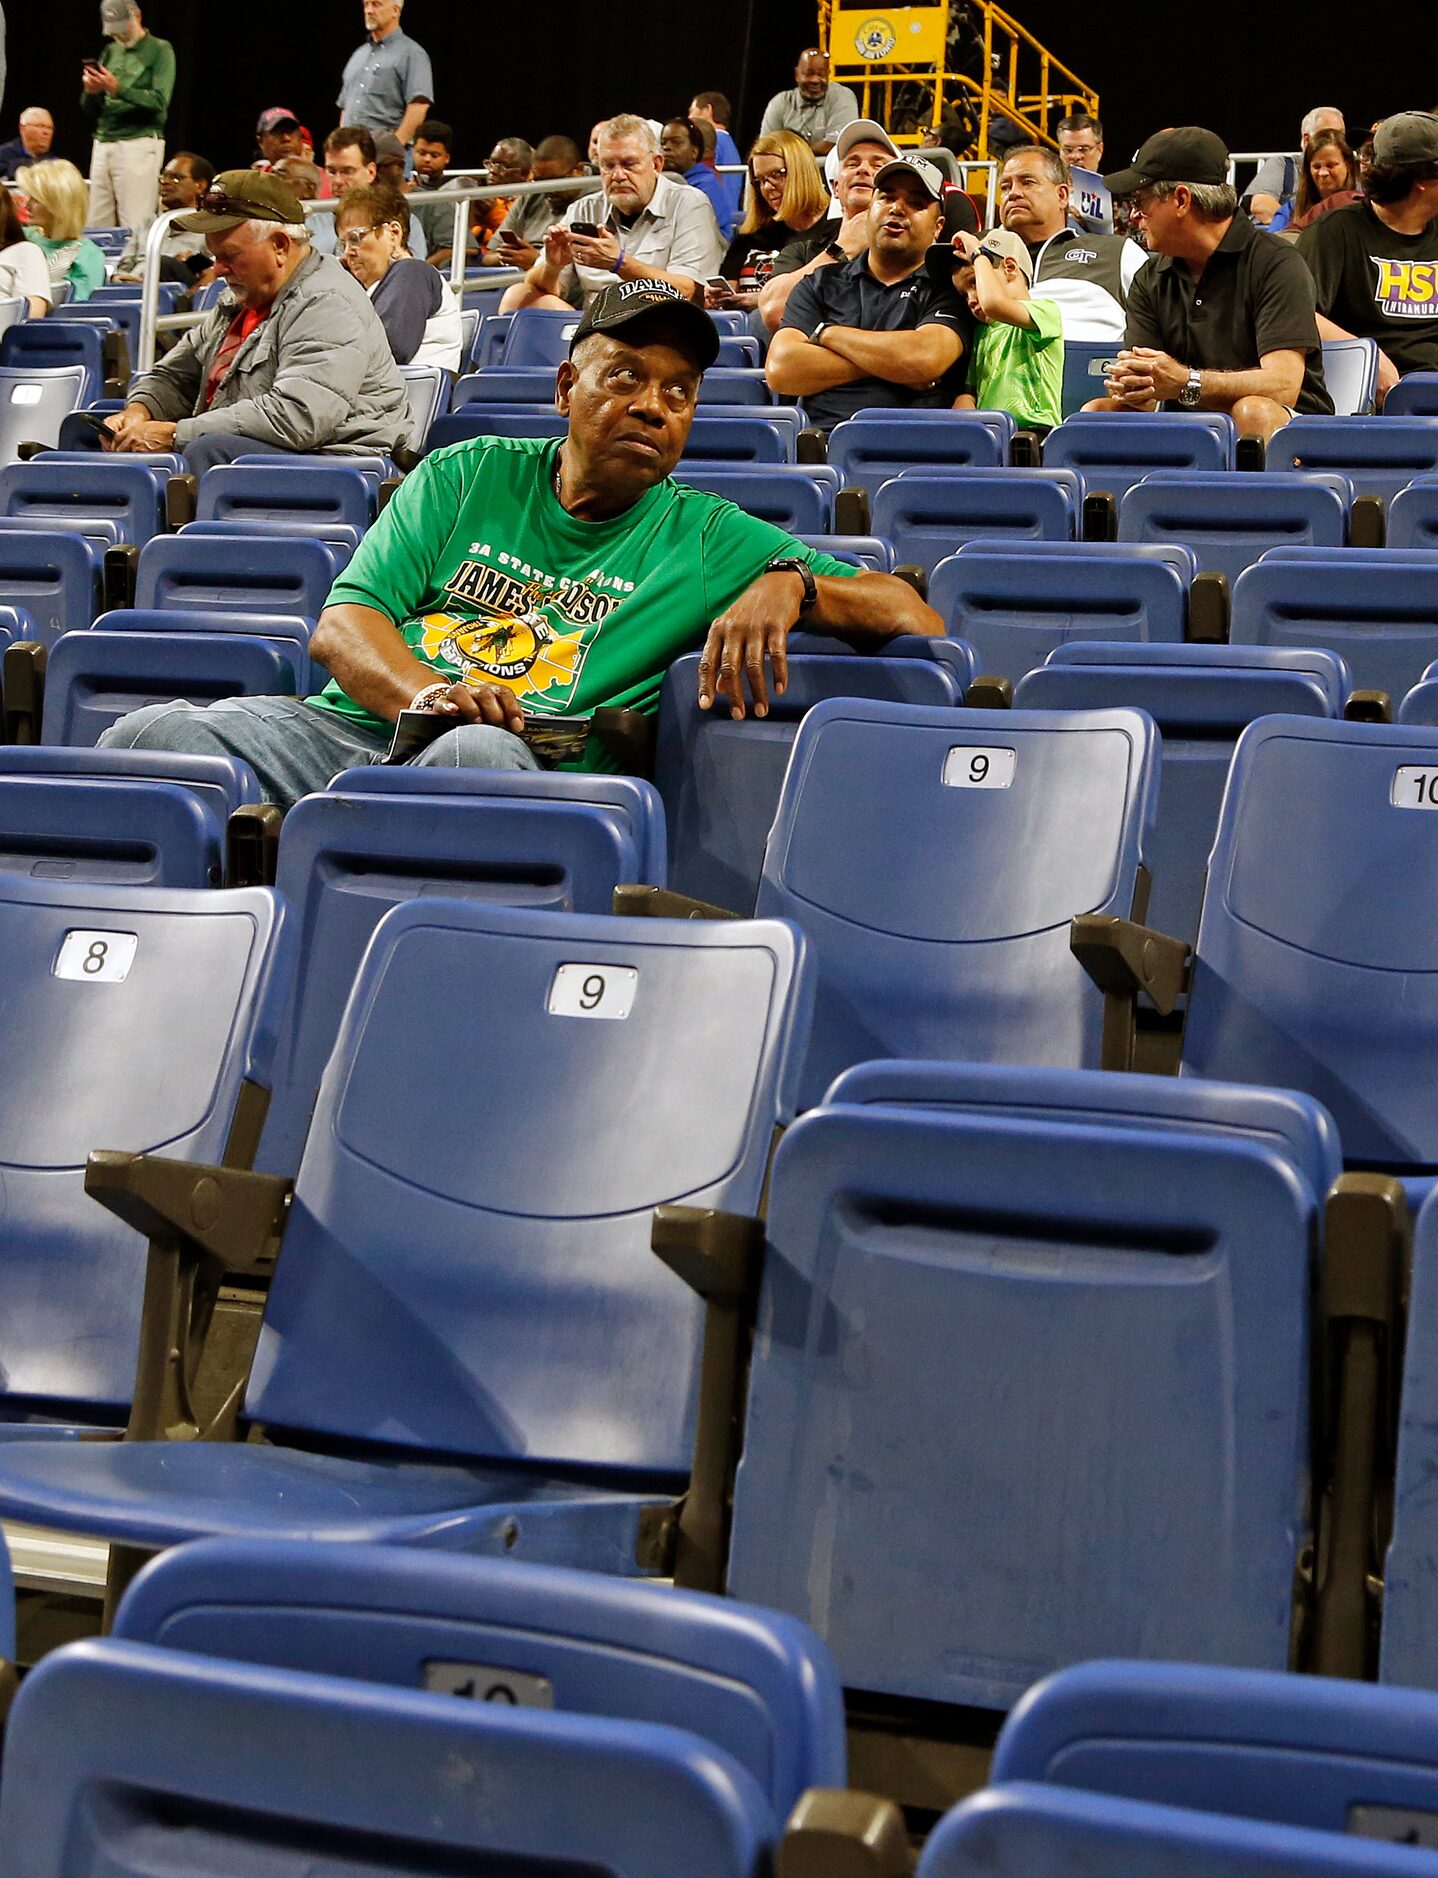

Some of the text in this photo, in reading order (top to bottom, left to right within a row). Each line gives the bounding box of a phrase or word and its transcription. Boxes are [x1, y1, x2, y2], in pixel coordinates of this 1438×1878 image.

[467, 541, 492, 558] 3A
[497, 551, 557, 590] STATE
[443, 559, 532, 616] JAMES
[968, 754, 990, 783] 9
[82, 940, 109, 974] 8
[578, 974, 606, 1010] 9
